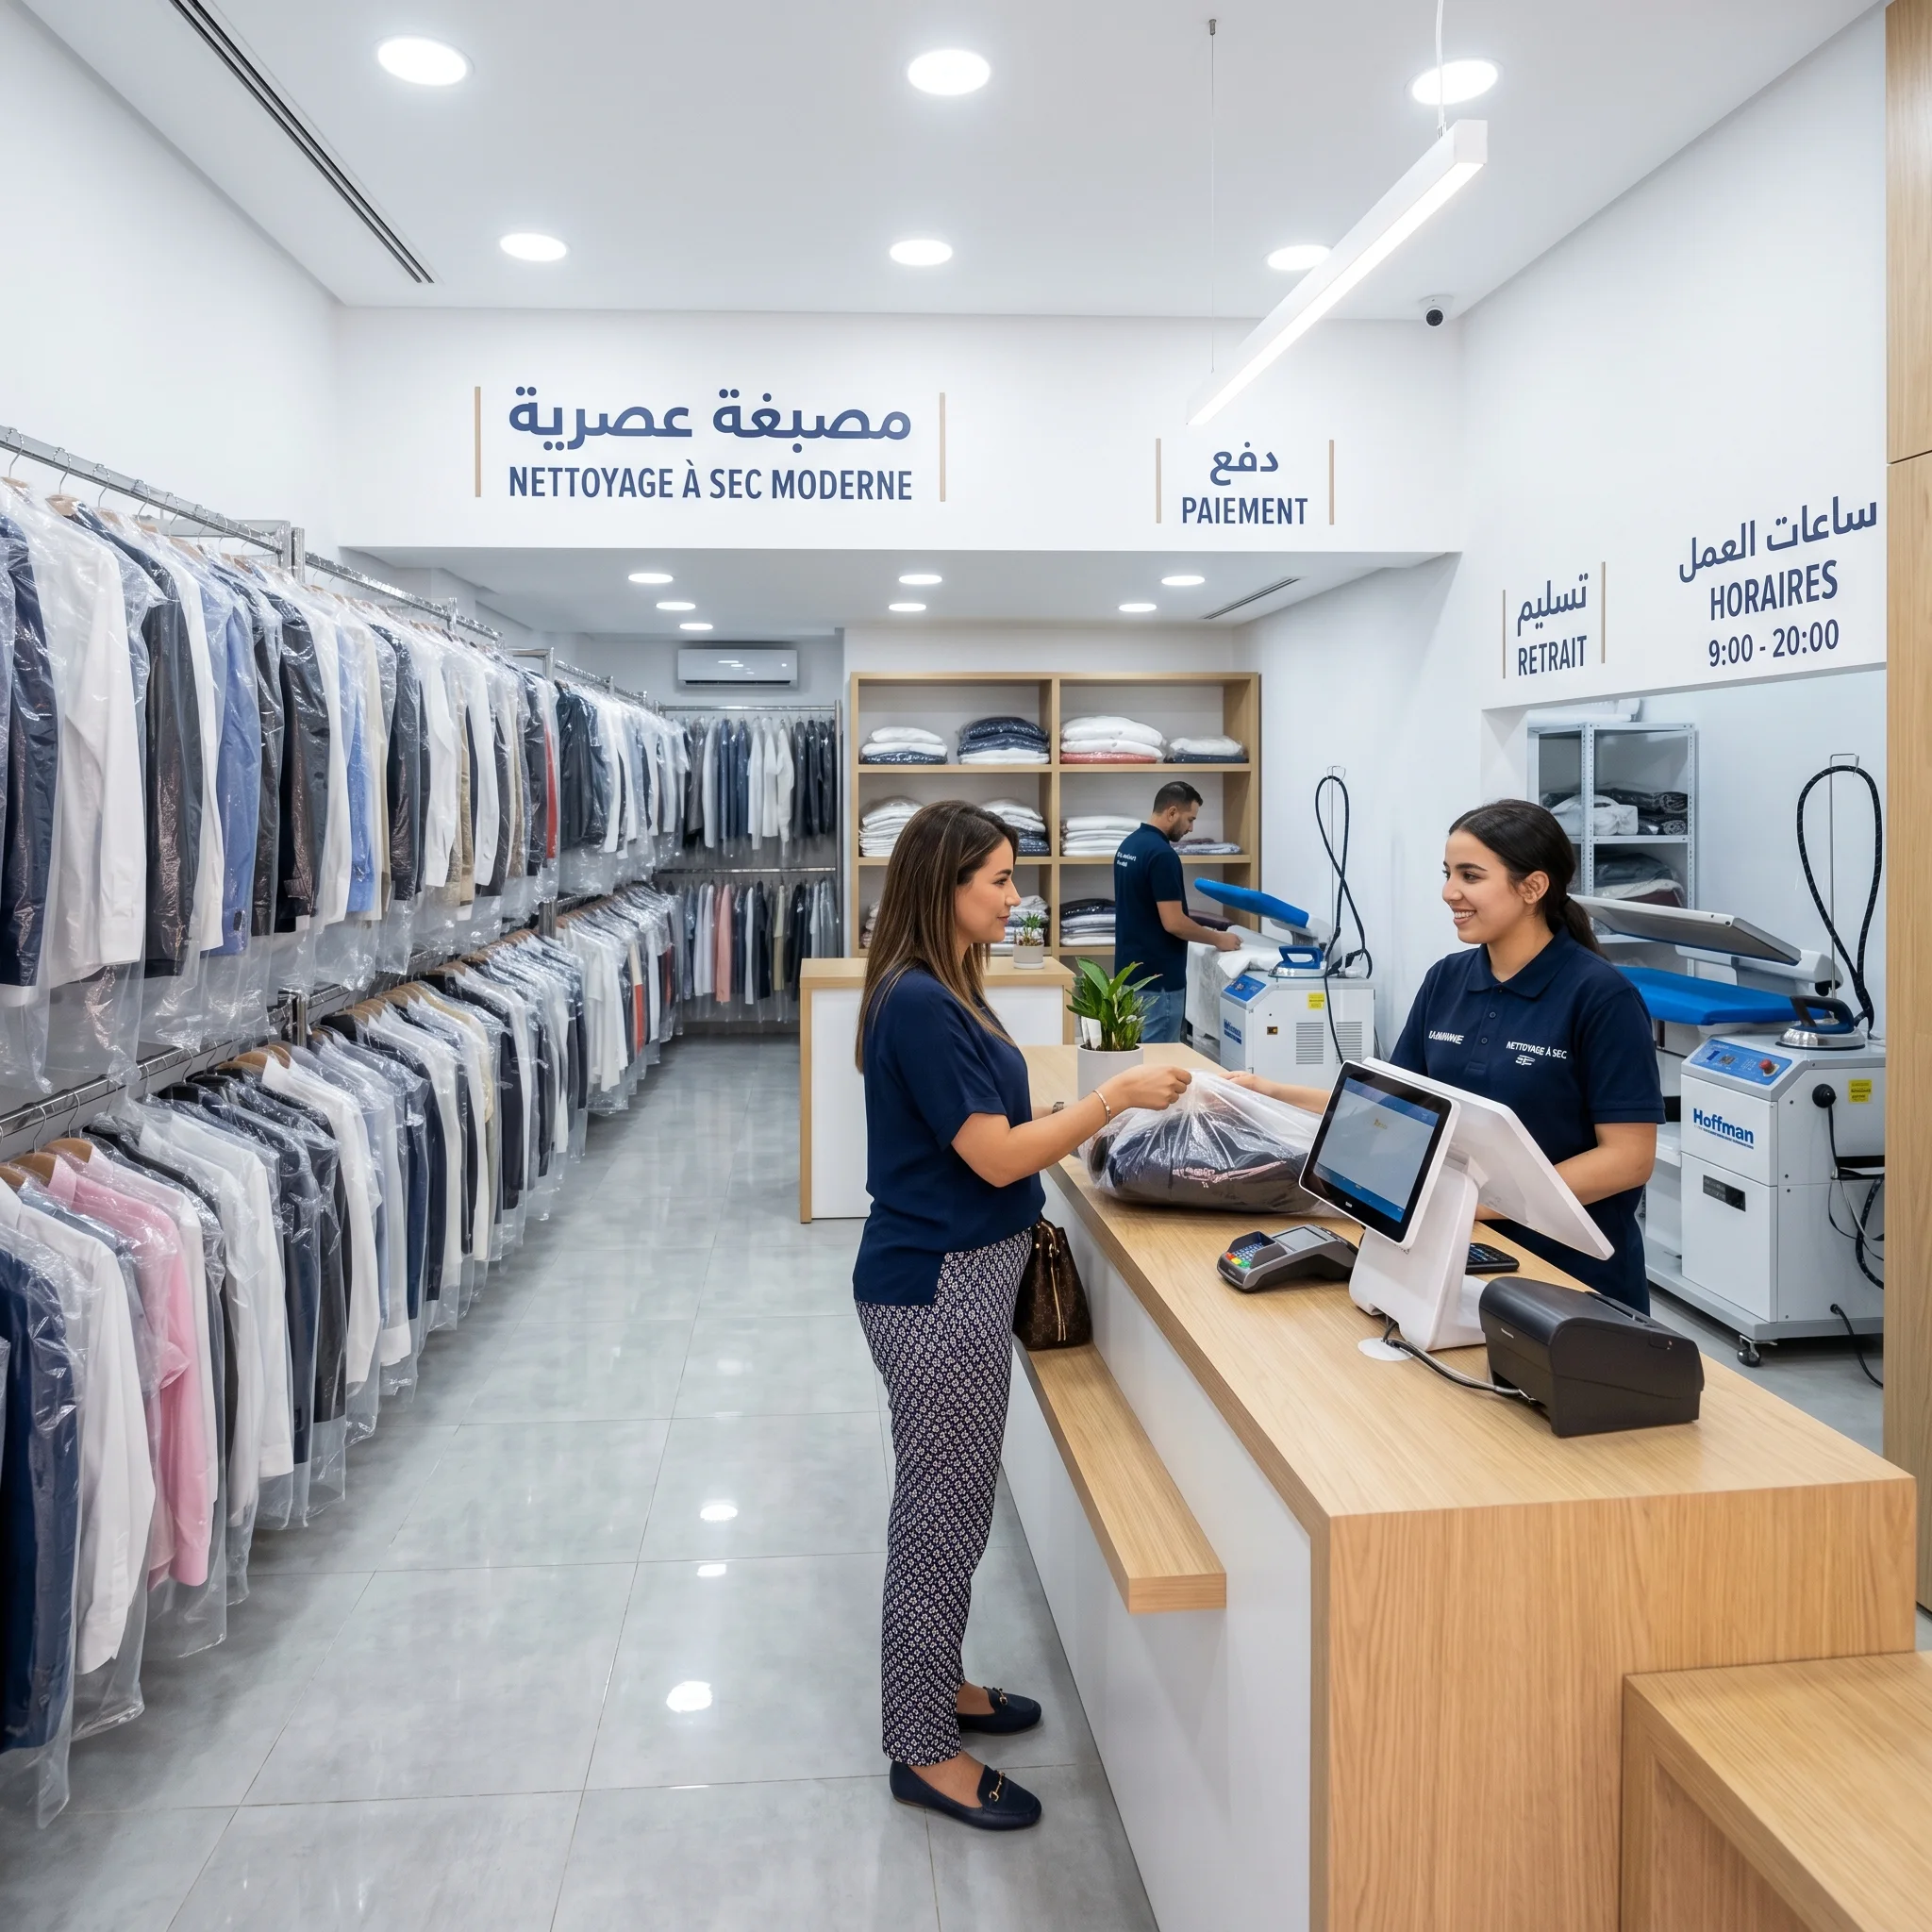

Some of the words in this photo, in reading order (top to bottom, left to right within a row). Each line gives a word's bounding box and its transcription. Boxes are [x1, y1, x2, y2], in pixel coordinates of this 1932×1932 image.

[508, 386, 692, 452] عصرية
[712, 388, 911, 454] مصبغة
[509, 466, 674, 498] NETTOYAGE
[682, 458, 702, 499] À
[709, 468, 762, 500] SEC
[772, 469, 912, 501] MODERNE
[1209, 441, 1279, 487] دفع
[1182, 496, 1308, 525] PAIEMENT
[1766, 495, 1877, 553] ساعات
[1679, 519, 1757, 584] العمل
[1517, 573, 1589, 638] تسليم
[1709, 559, 1839, 622] HORAIRES
[1518, 635, 1588, 676] RETRAIT
[1708, 633, 1754, 668] 9:00
[1773, 618, 1840, 658] 20:00
[1552, 1049, 1567, 1059] SEC
[1693, 1108, 1754, 1144] Hoffman
